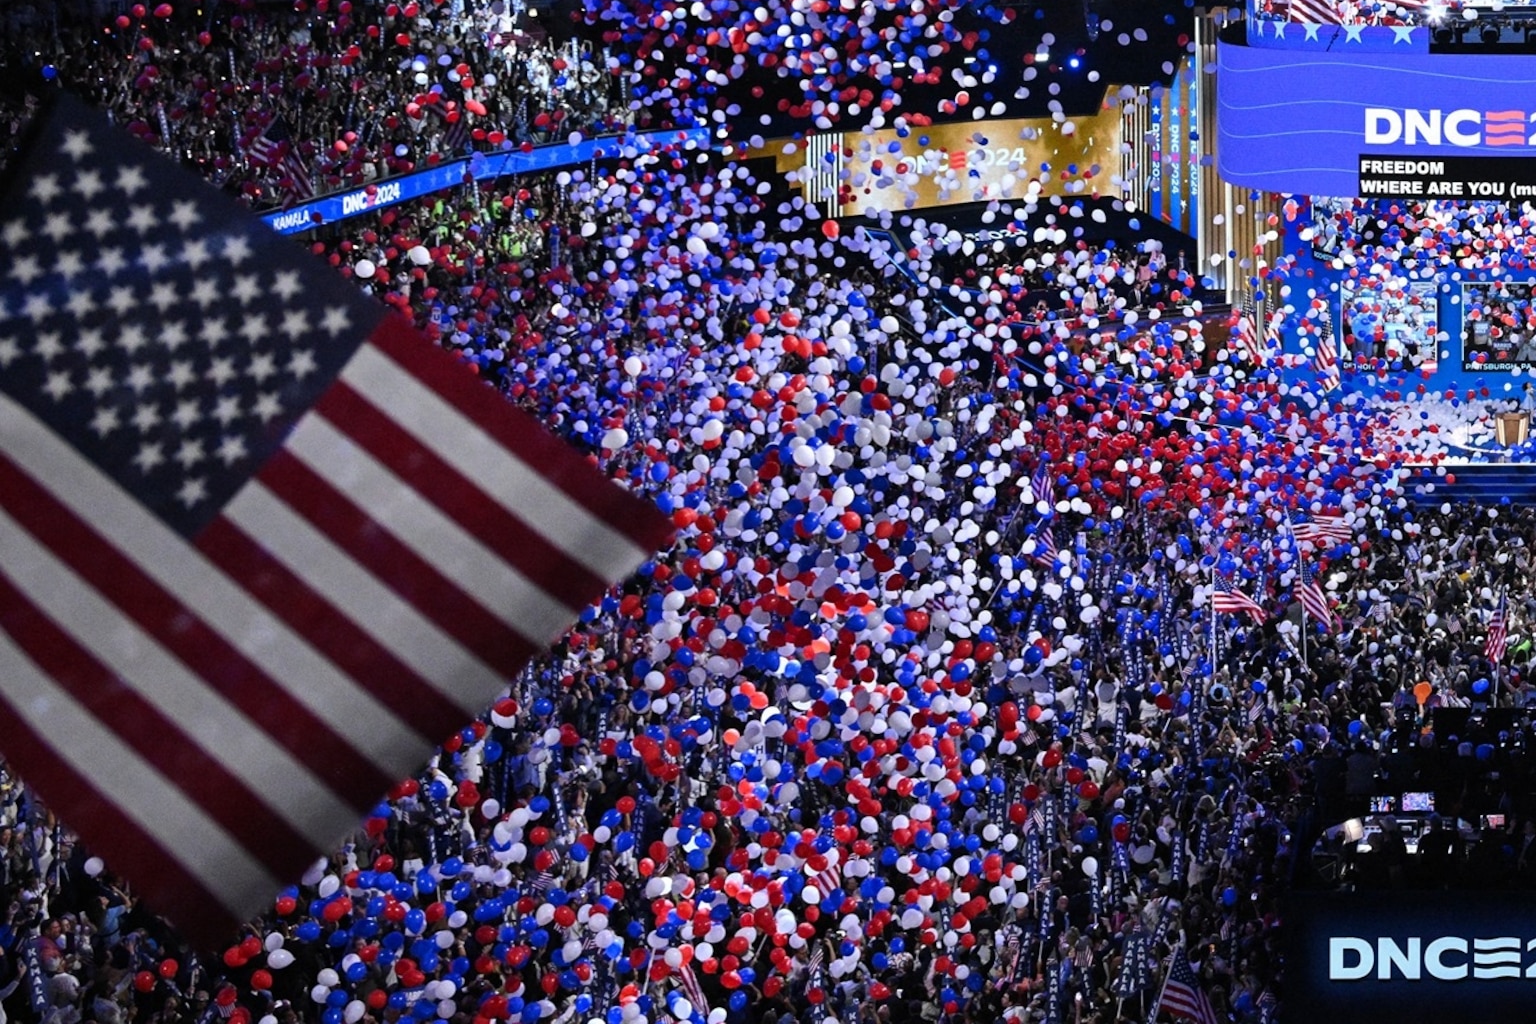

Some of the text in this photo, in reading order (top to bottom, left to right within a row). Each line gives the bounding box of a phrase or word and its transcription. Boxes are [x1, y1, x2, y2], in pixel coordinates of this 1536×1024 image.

[1364, 108, 1481, 146] DNC
[1361, 161, 1444, 175] FREEDOM
[375, 182, 400, 205] 2024
[1360, 180, 1423, 196] WHERE
[1427, 181, 1464, 196] ARE
[1468, 182, 1505, 196] YOU
[273, 210, 310, 230] KAMALA
[1116, 711, 1124, 749] KAMALA
[1173, 837, 1181, 881] KAMALA
[1120, 941, 1135, 992] KAMALA
[1137, 937, 1146, 985] KAMALA
[1329, 937, 1468, 980] DNC
[1050, 969, 1058, 1018] KAMALA
